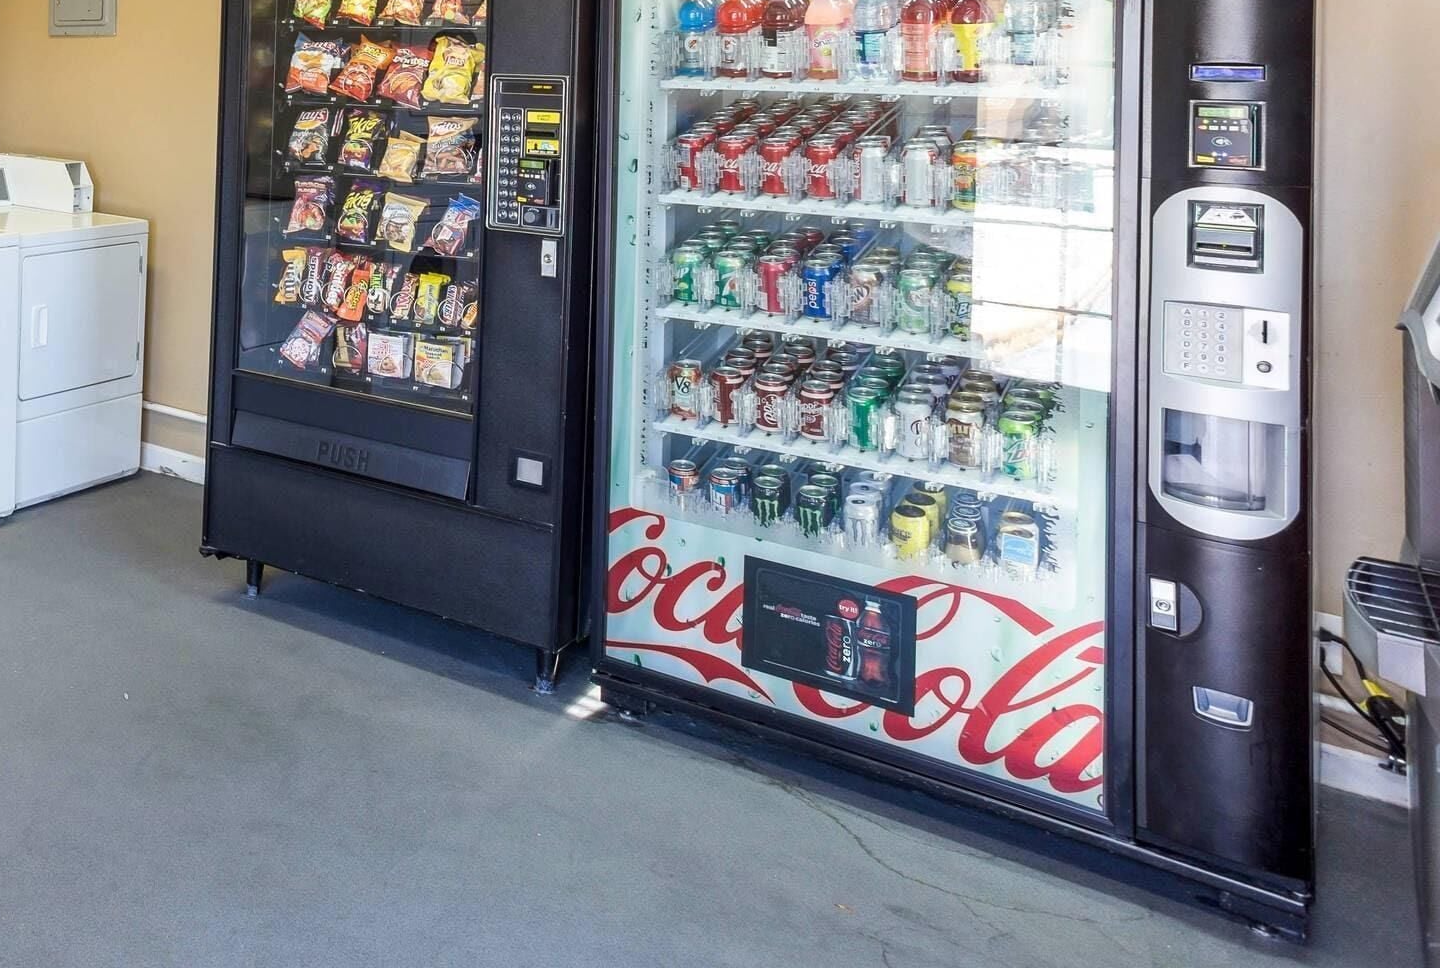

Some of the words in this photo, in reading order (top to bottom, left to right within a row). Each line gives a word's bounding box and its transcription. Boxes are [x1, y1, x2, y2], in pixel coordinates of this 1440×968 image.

[393, 55, 430, 68] Doritos
[304, 256, 318, 302] Mounds
[808, 278, 819, 309] pepsi
[675, 376, 691, 394] V8
[317, 440, 369, 473] PUSH
[842, 635, 851, 663] zero
[863, 638, 881, 648] zero
